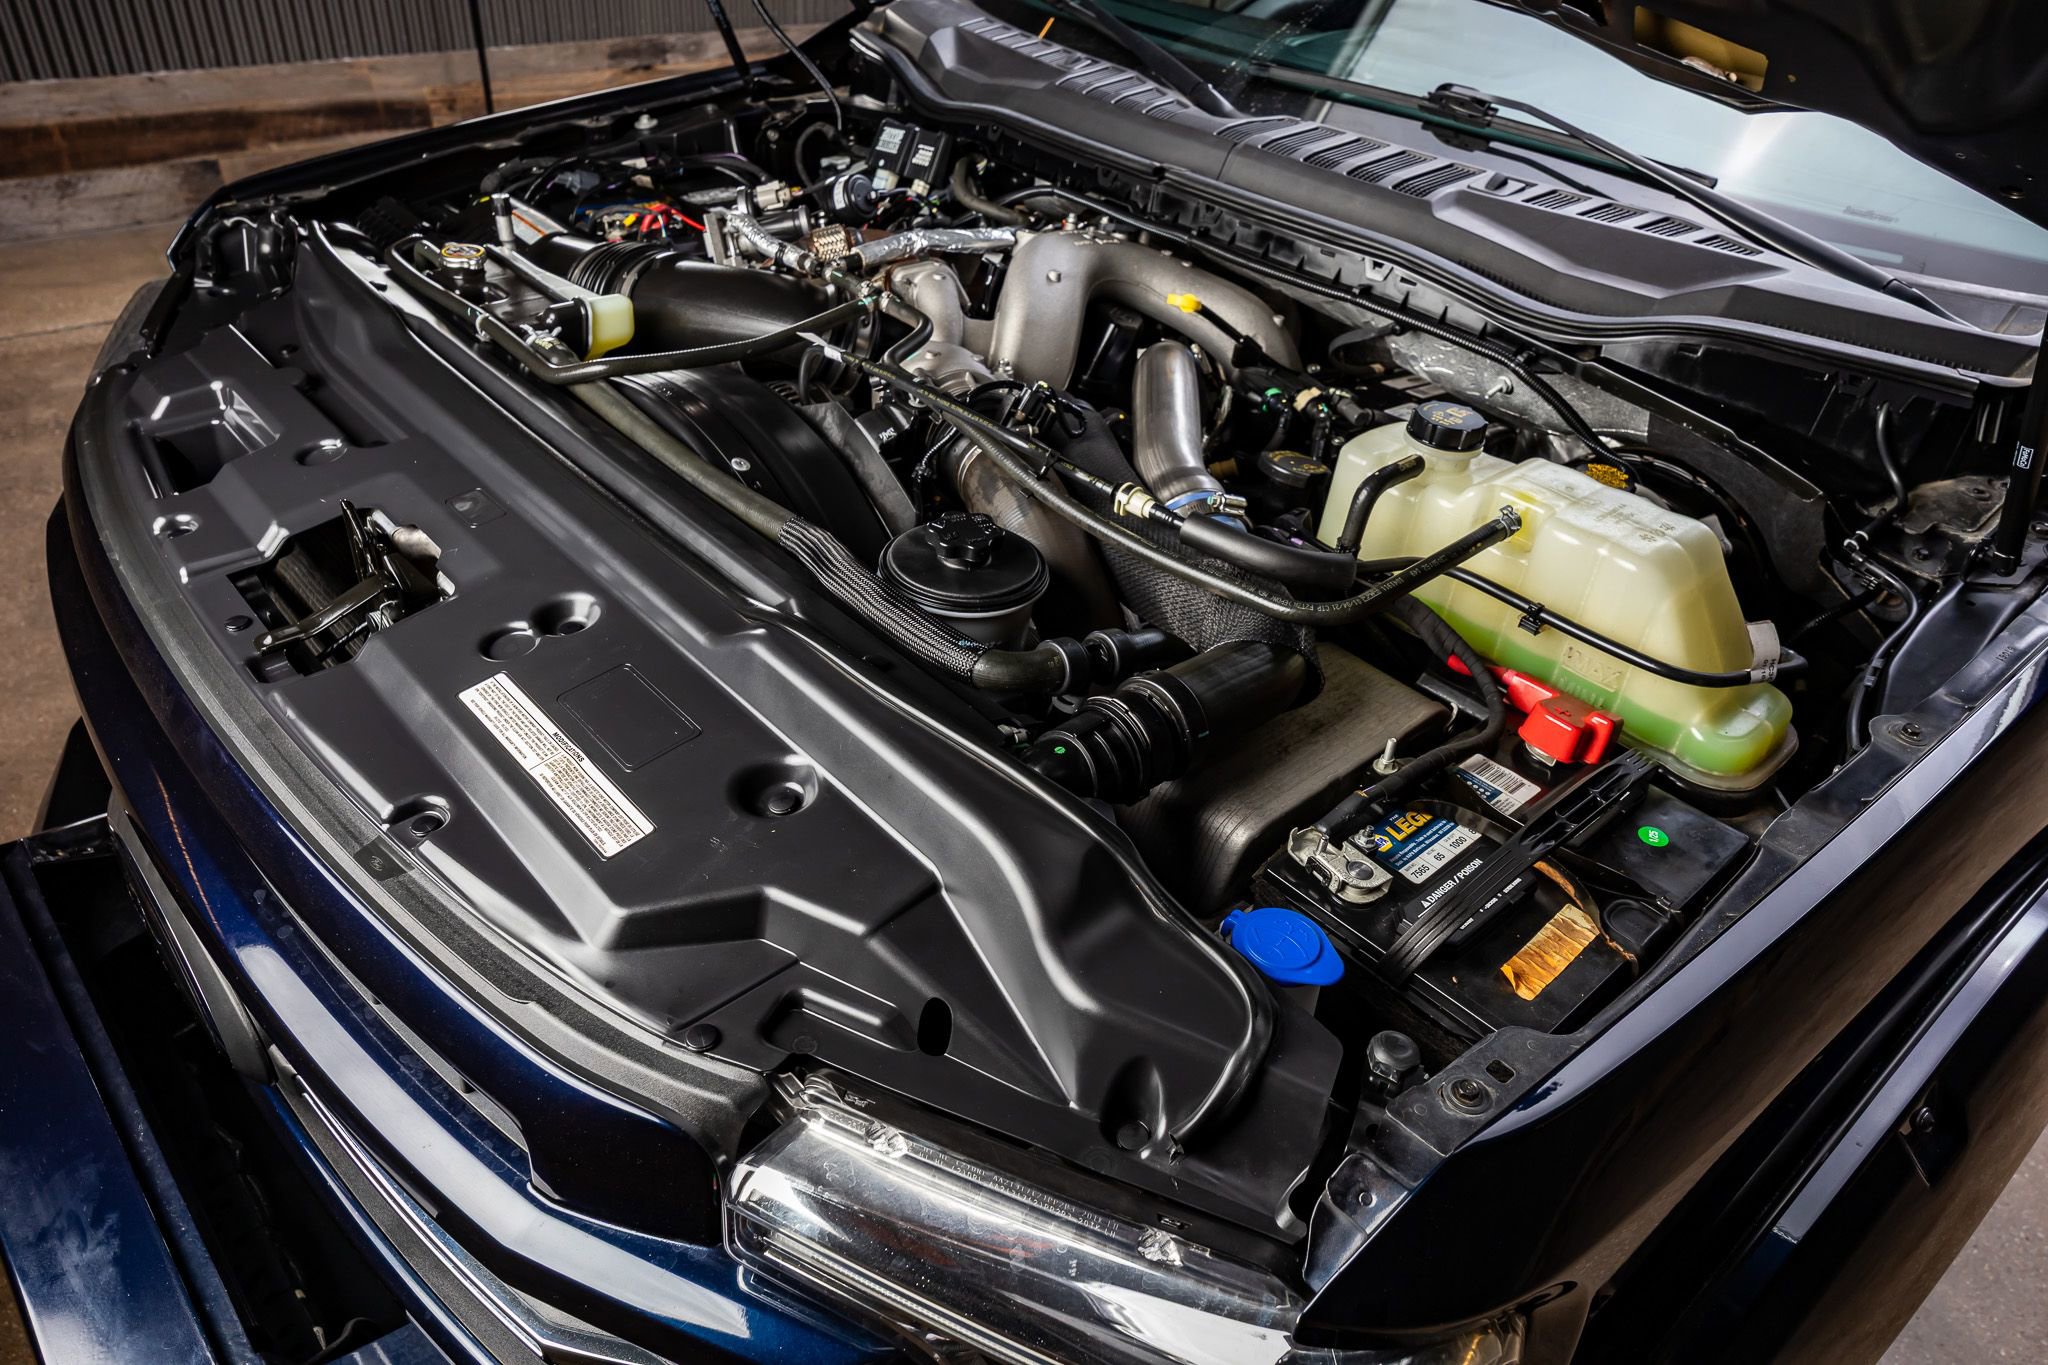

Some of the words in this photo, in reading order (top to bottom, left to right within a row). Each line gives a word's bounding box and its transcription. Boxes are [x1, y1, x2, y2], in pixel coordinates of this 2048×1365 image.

[2019, 447, 2031, 468] FoMoCo
[552, 732, 585, 763] MODIFICATIONS
[1449, 836, 1468, 849] 1000
[1433, 852, 1446, 862] 65
[1411, 864, 1430, 879] 7565
[1426, 880, 1457, 903] DANGER
[1458, 858, 1483, 879] POISON
